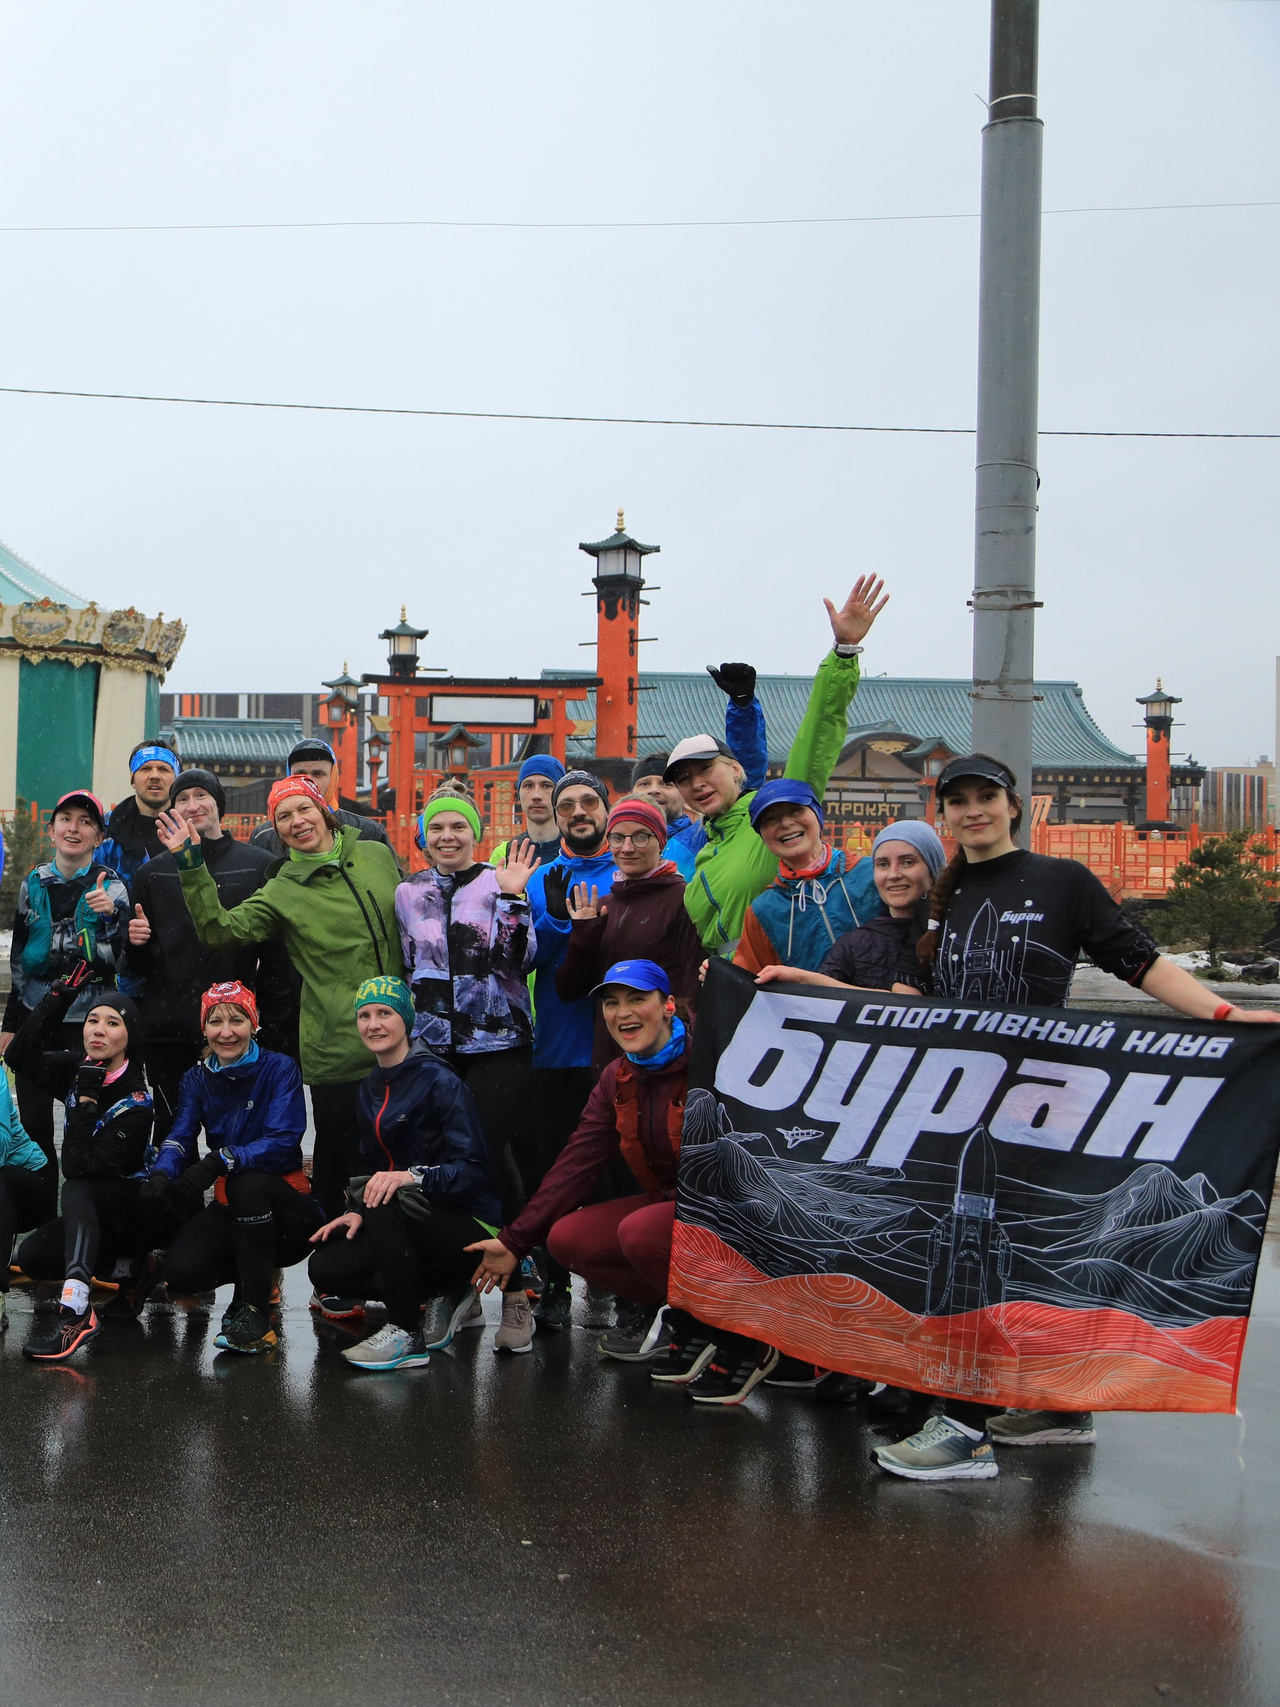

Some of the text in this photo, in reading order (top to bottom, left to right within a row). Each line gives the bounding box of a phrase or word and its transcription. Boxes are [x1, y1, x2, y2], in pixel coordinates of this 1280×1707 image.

[826, 801, 902, 817] ПРОКАТ
[999, 910, 1045, 924] Буран
[856, 1003, 1235, 1059] СПОРТИВНЫЙ КЛУБ
[714, 990, 1225, 1168] Буран
